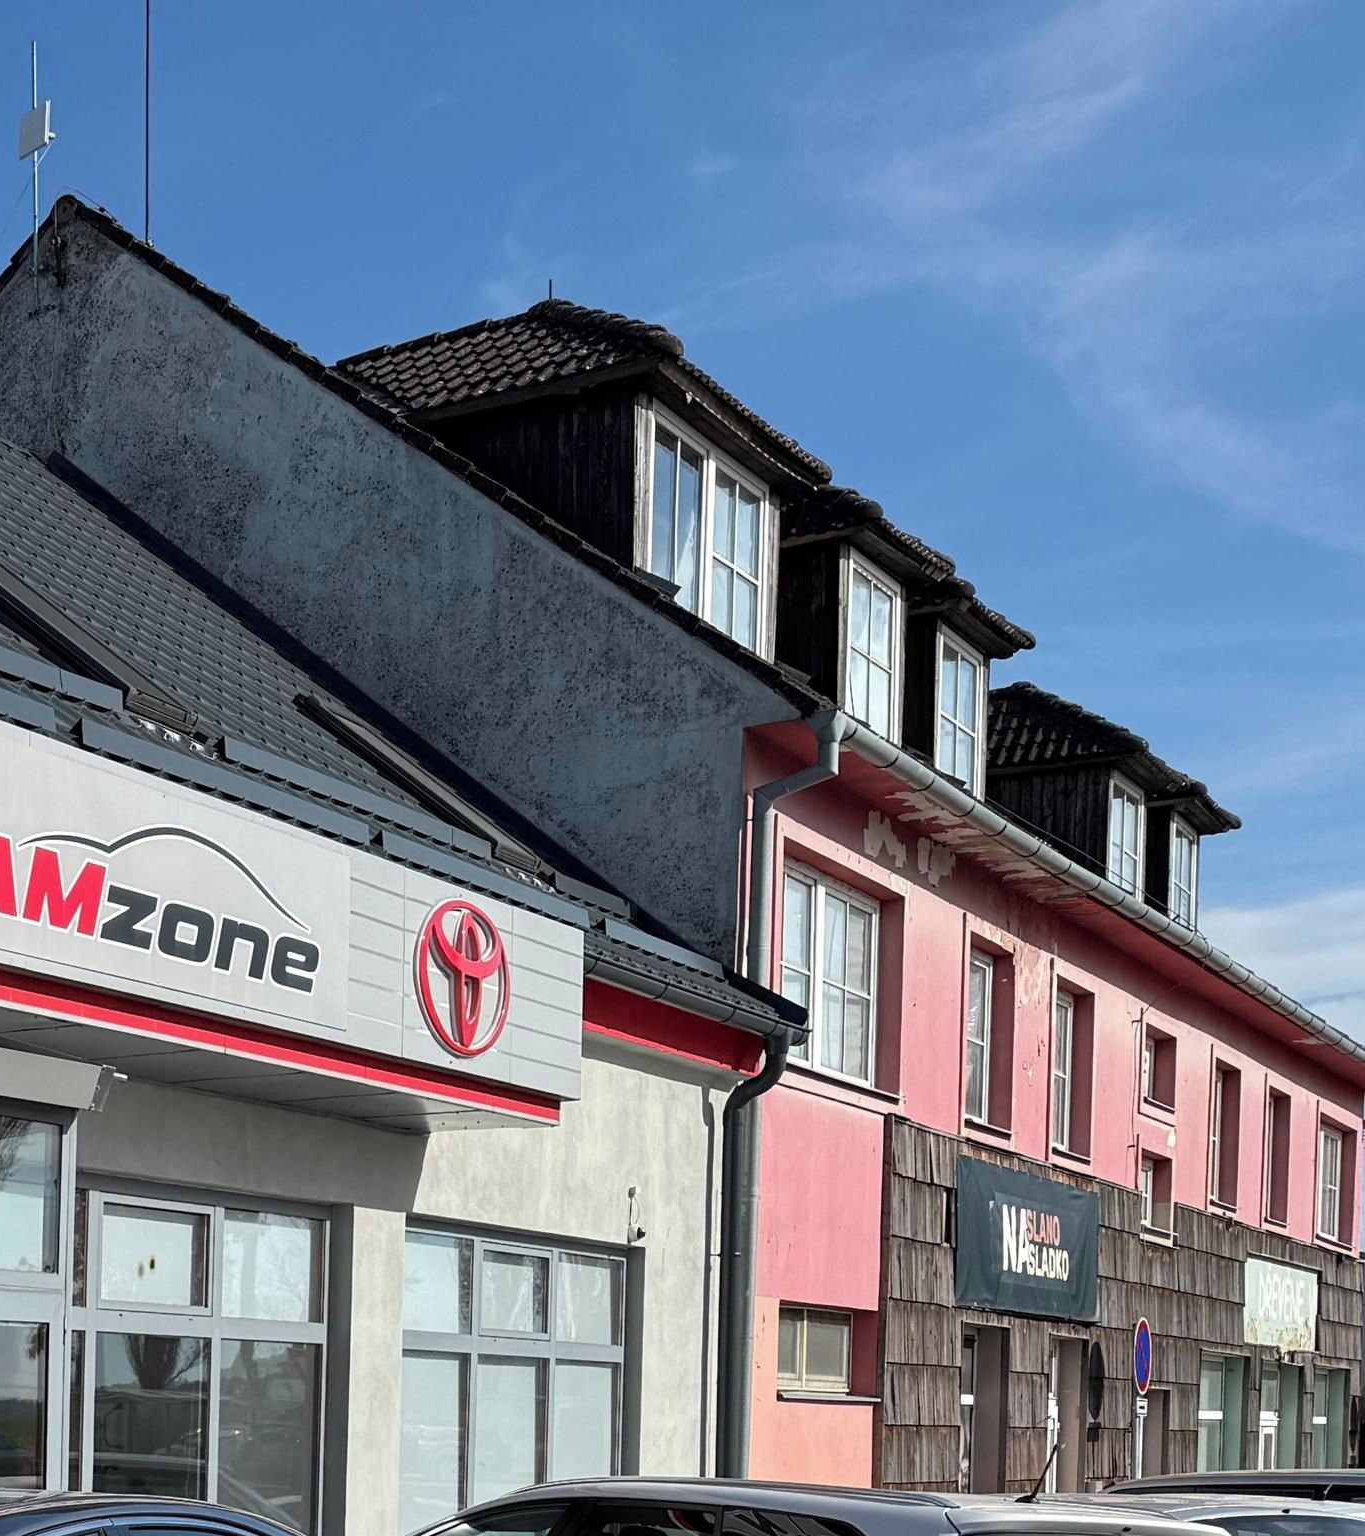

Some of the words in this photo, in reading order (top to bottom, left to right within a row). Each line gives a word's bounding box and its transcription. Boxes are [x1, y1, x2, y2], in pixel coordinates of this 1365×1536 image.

[1002, 1204, 1029, 1273] NA
[1026, 1208, 1060, 1246] SLANO
[1027, 1244, 1069, 1281] SLADKO
